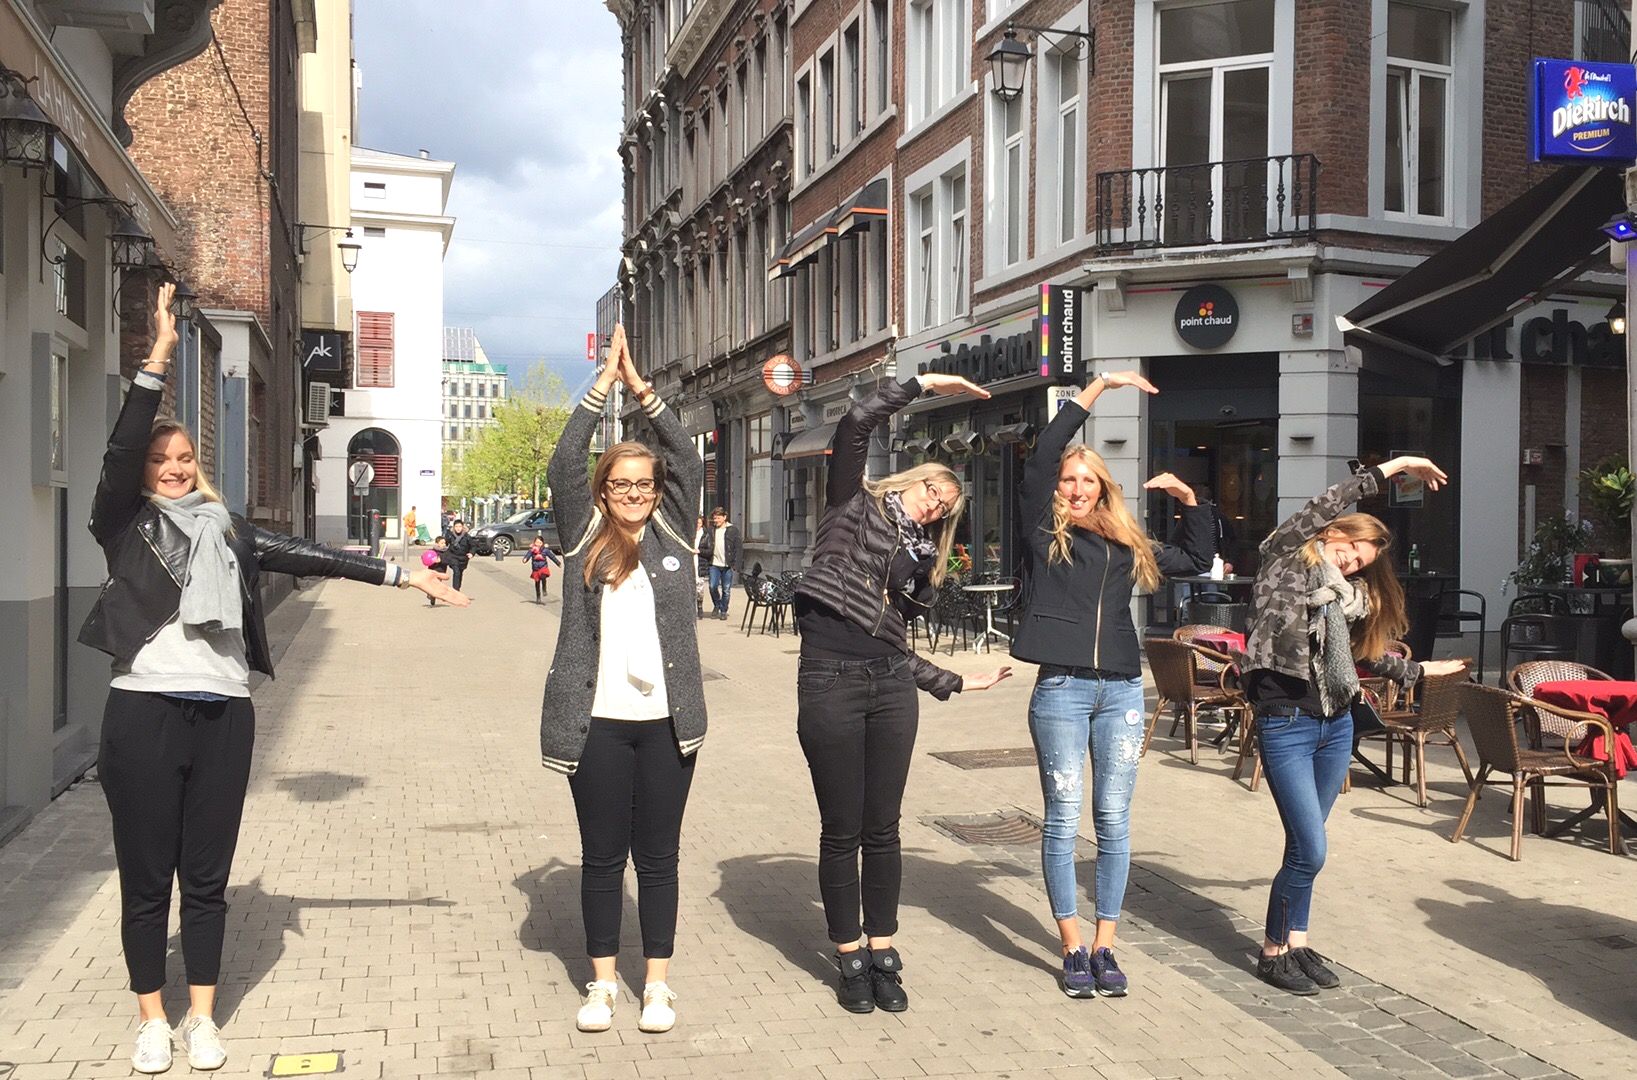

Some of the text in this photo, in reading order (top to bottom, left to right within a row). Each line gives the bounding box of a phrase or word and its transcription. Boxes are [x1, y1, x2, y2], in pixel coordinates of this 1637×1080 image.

[53, 77, 89, 158] HALTE
[1552, 94, 1631, 138] Diekirch
[1573, 128, 1610, 141] PREMIUM
[1061, 289, 1074, 373] point chaud
[1180, 314, 1232, 329] point chaud
[1055, 389, 1076, 397] ZONE
